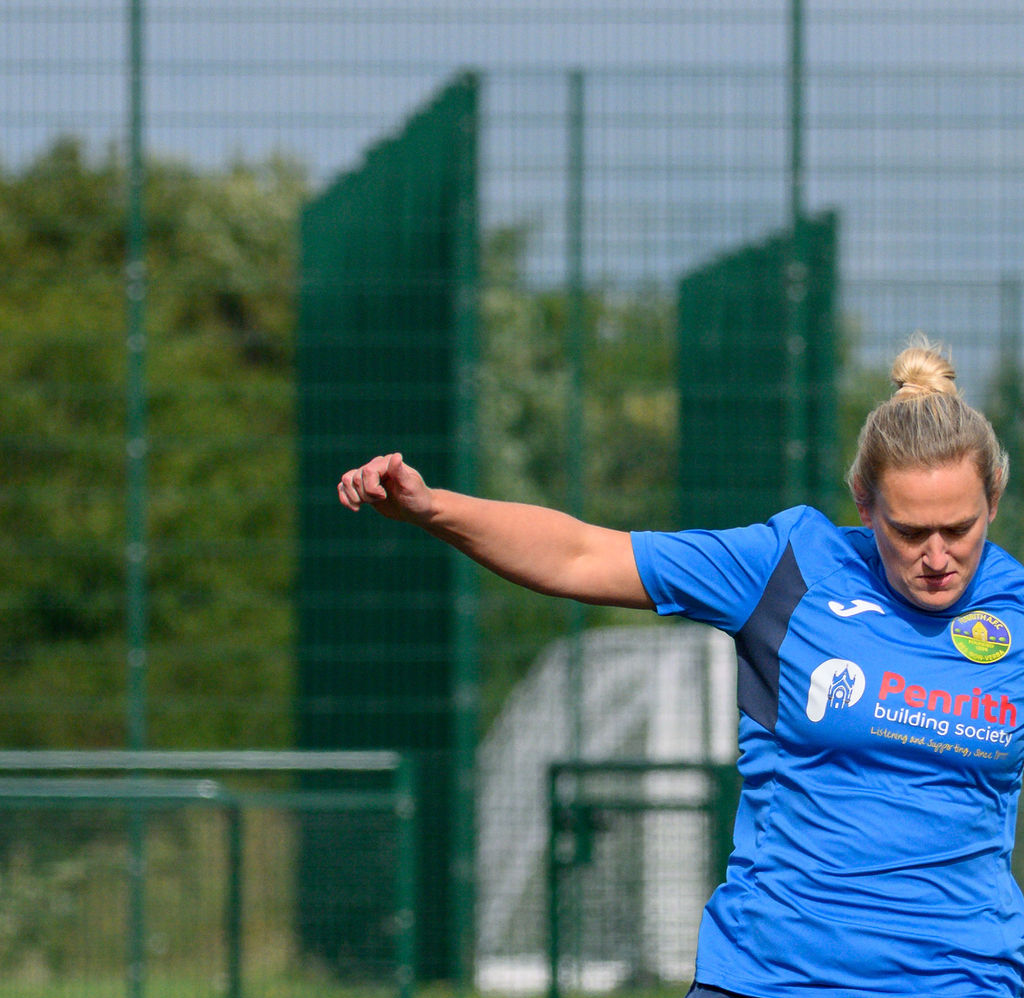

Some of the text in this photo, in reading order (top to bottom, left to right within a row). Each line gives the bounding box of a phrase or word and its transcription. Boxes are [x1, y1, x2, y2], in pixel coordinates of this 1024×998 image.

[878, 671, 1017, 727] Penrith
[870, 726, 908, 745] Listening
[910, 735, 925, 745] and
[874, 703, 1013, 747] building society
